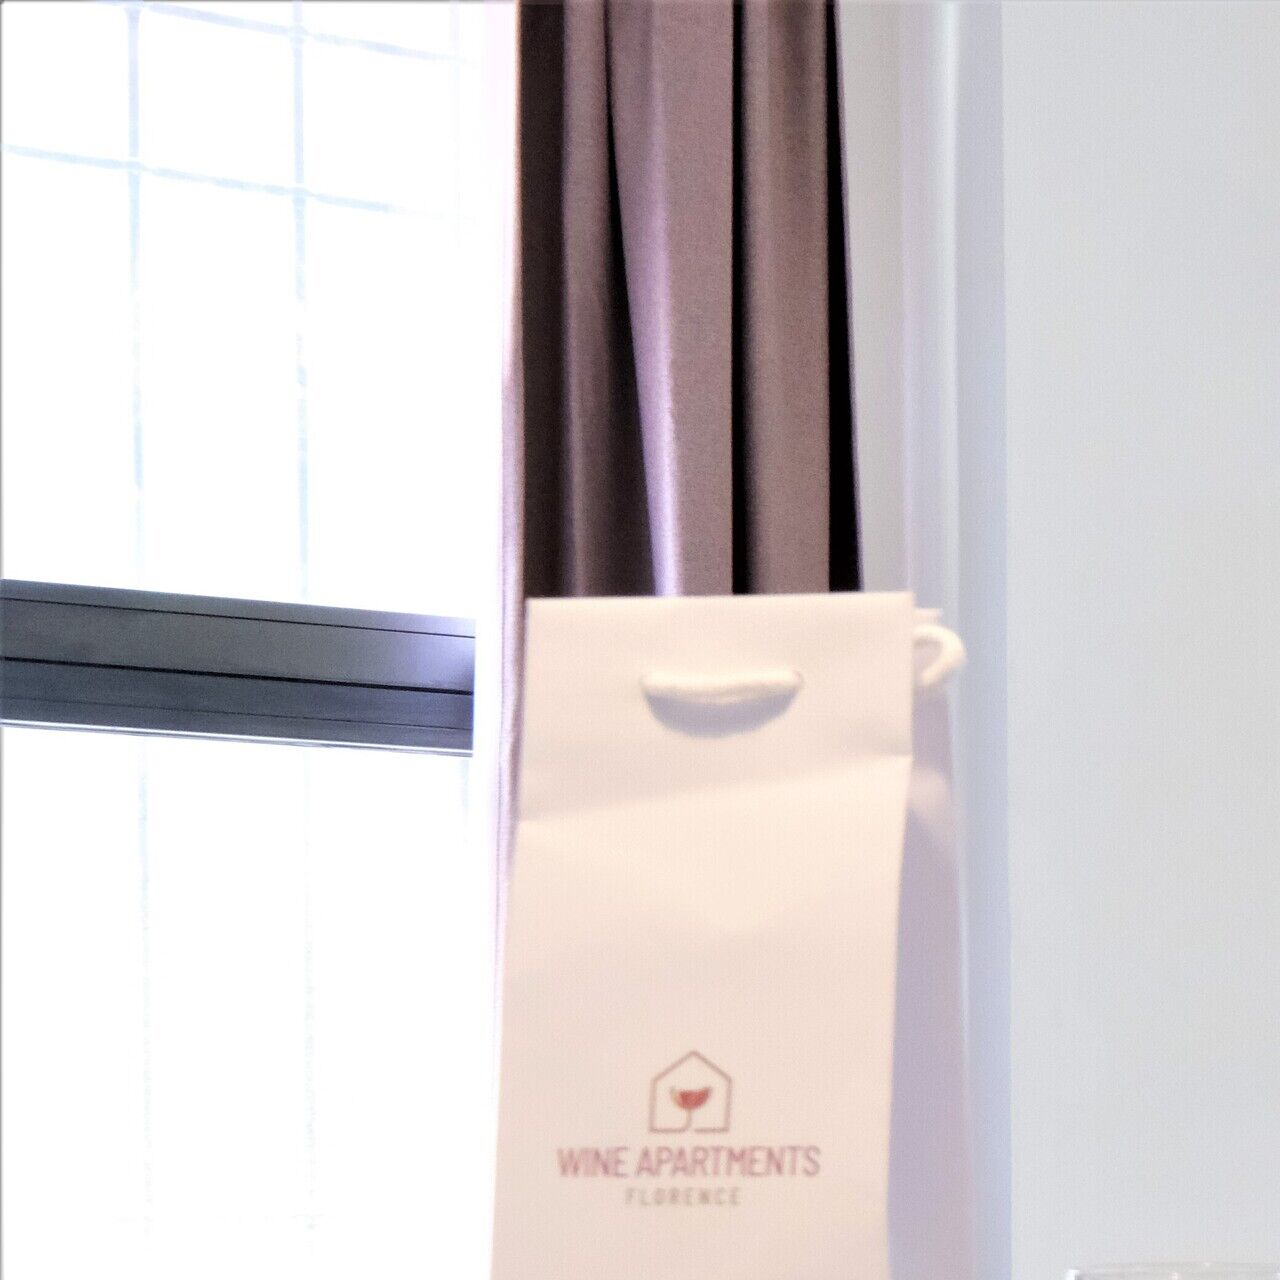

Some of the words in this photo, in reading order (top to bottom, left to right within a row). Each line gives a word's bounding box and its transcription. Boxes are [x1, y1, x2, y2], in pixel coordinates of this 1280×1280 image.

[556, 1146, 629, 1178] WINE
[634, 1145, 822, 1178] APARTMENTS
[625, 1186, 741, 1206] FLORENCE
